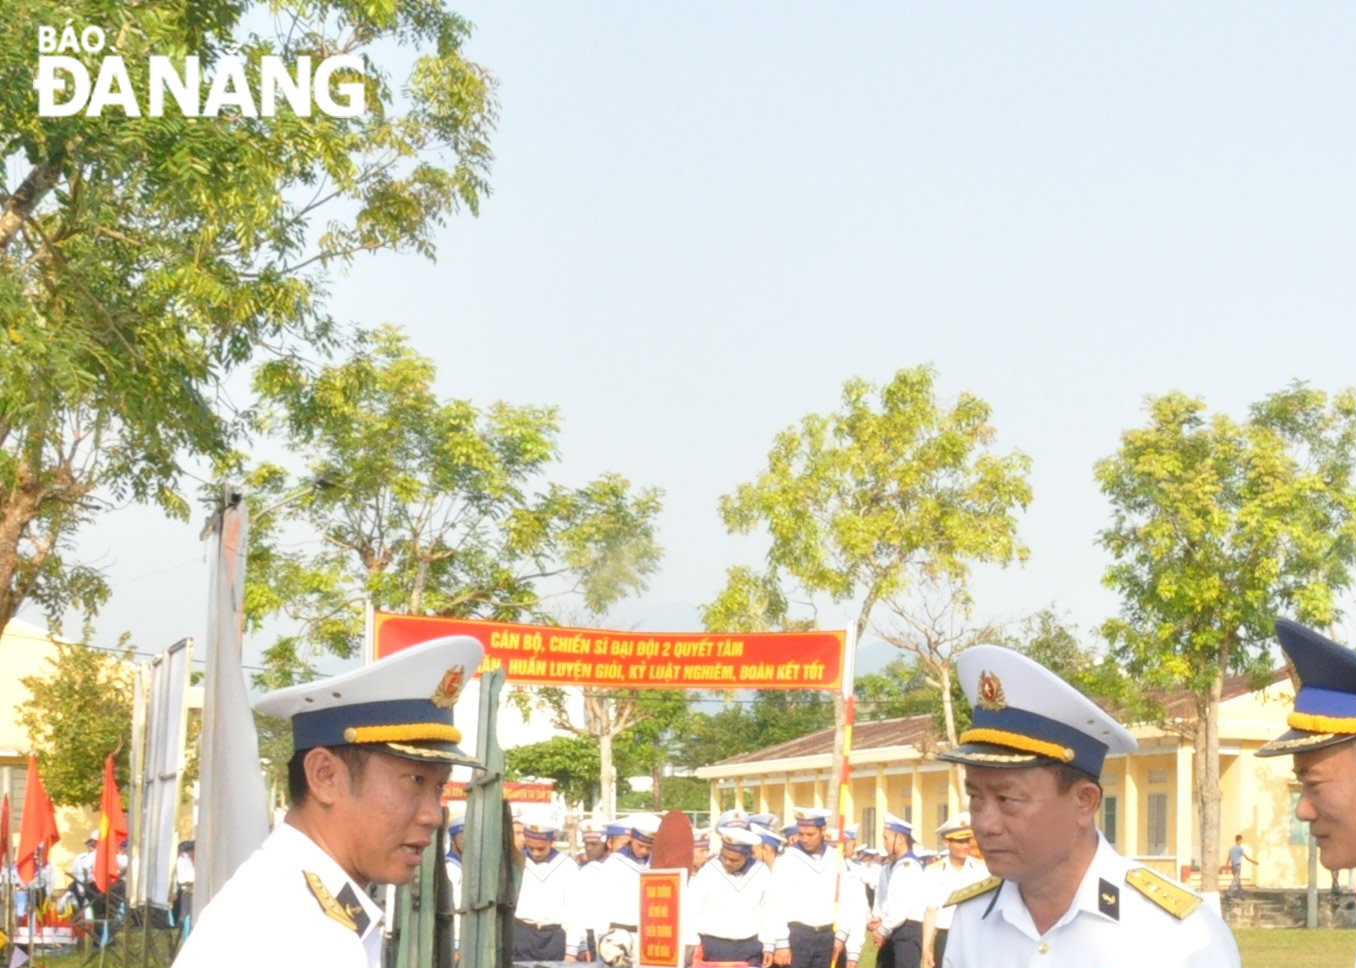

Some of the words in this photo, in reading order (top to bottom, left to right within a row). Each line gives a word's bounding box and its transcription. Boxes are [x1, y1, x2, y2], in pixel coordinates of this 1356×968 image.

[490, 630, 520, 648] CÁN
[523, 632, 546, 654] BỘ,
[550, 633, 591, 654] CHIẾN
[593, 637, 608, 655] SĨ
[611, 641, 634, 660] ĐẠI
[636, 640, 659, 660] ĐỘI
[662, 642, 671, 657] 2
[673, 636, 714, 659] QUYẾT
[717, 639, 744, 657] TÂM
[509, 655, 547, 677] HUẤN
[550, 660, 593, 680] LUYỆN
[595, 660, 625, 680] GIỎI,
[628, 661, 646, 679] KỶ
[649, 663, 681, 683] LUẬT
[683, 662, 736, 681] NGHIÊM,
[740, 661, 775, 680] ĐOÀN
[776, 659, 801, 680] KẾT
[803, 659, 825, 680] TỐT
